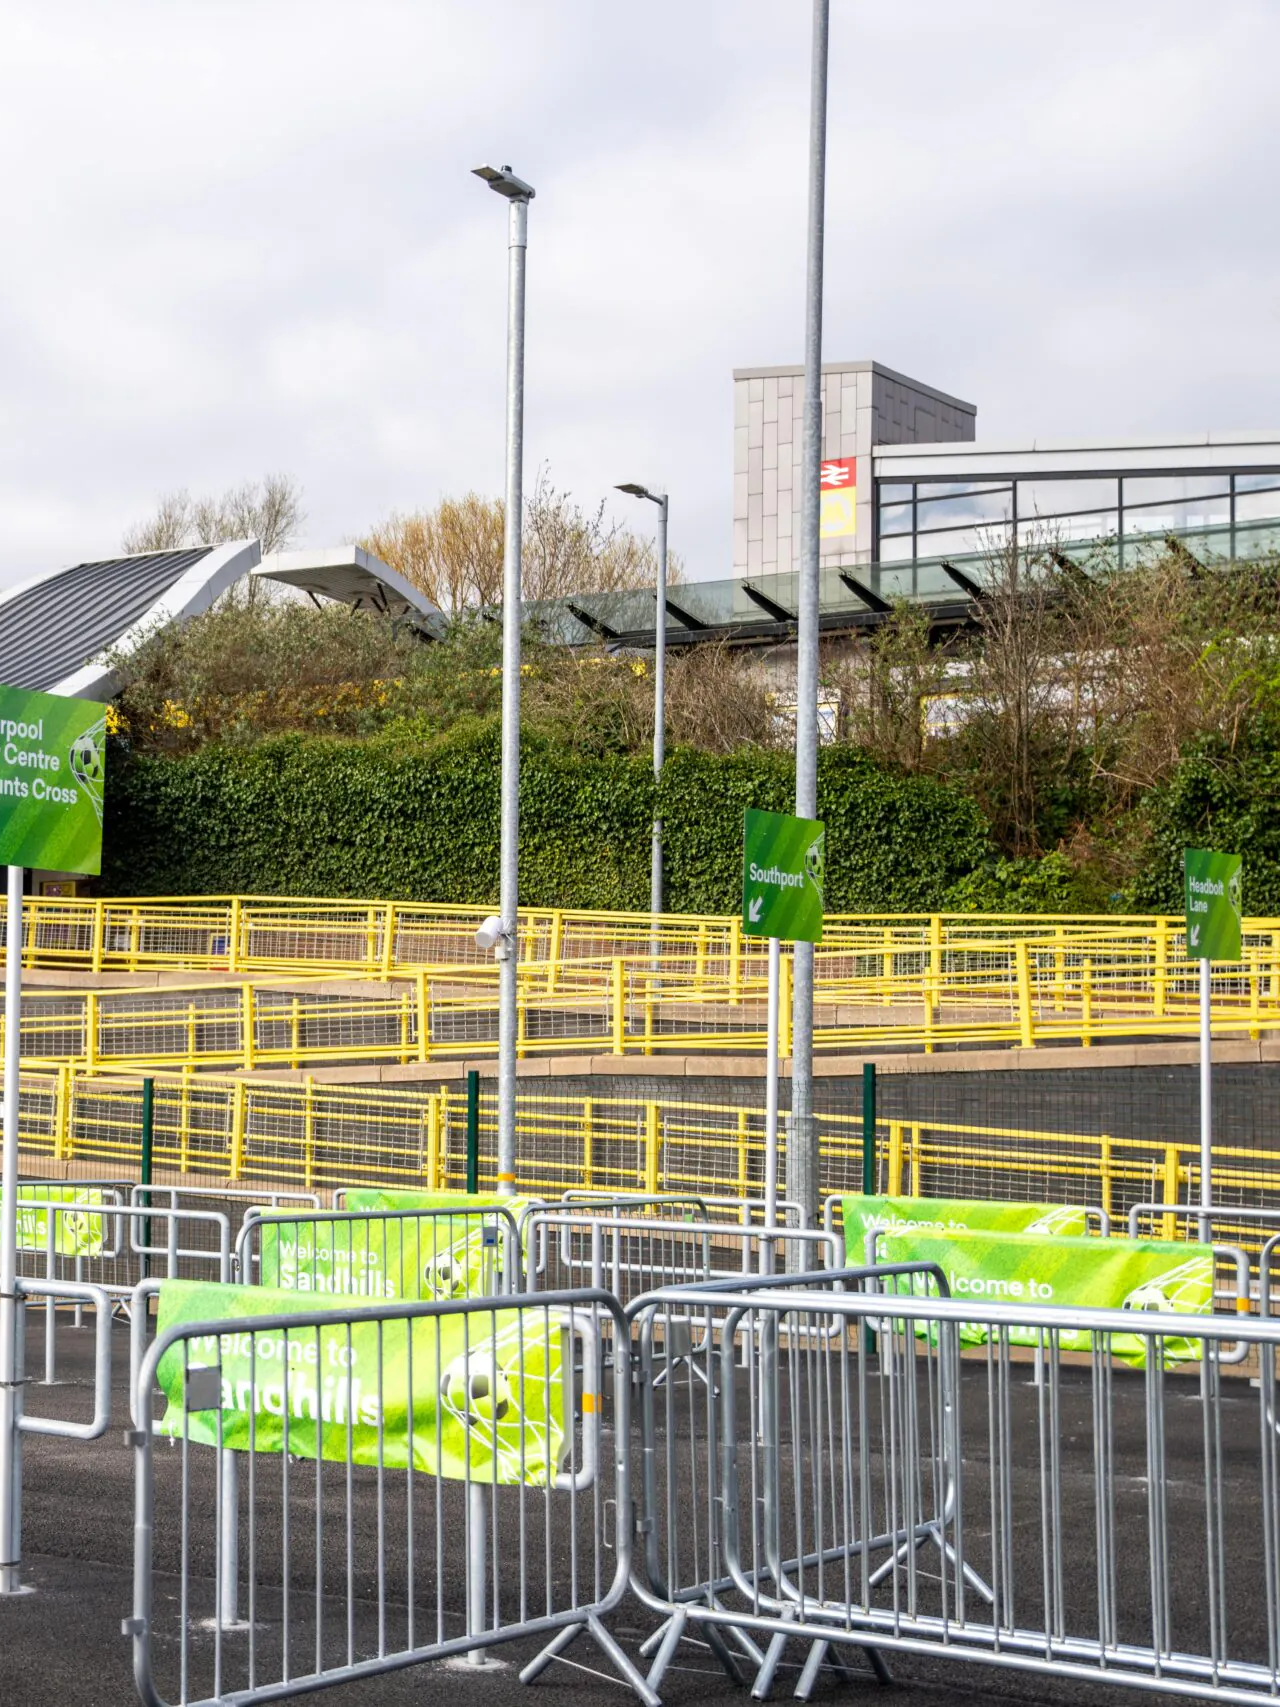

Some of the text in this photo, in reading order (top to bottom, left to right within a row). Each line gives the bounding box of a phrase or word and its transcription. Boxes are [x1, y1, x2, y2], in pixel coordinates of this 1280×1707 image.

[4, 743, 60, 771] Centre
[32, 778, 78, 804] Cross
[749, 862, 804, 891] Southport
[1189, 876, 1224, 896] Headbolt
[1190, 896, 1208, 912] Lane
[279, 1240, 378, 1265] Welcome to
[281, 1263, 395, 1298] Sandhills
[914, 1270, 1053, 1299] Wlcome to
[189, 1333, 357, 1367] Welcome to
[188, 1362, 384, 1426] andhills
